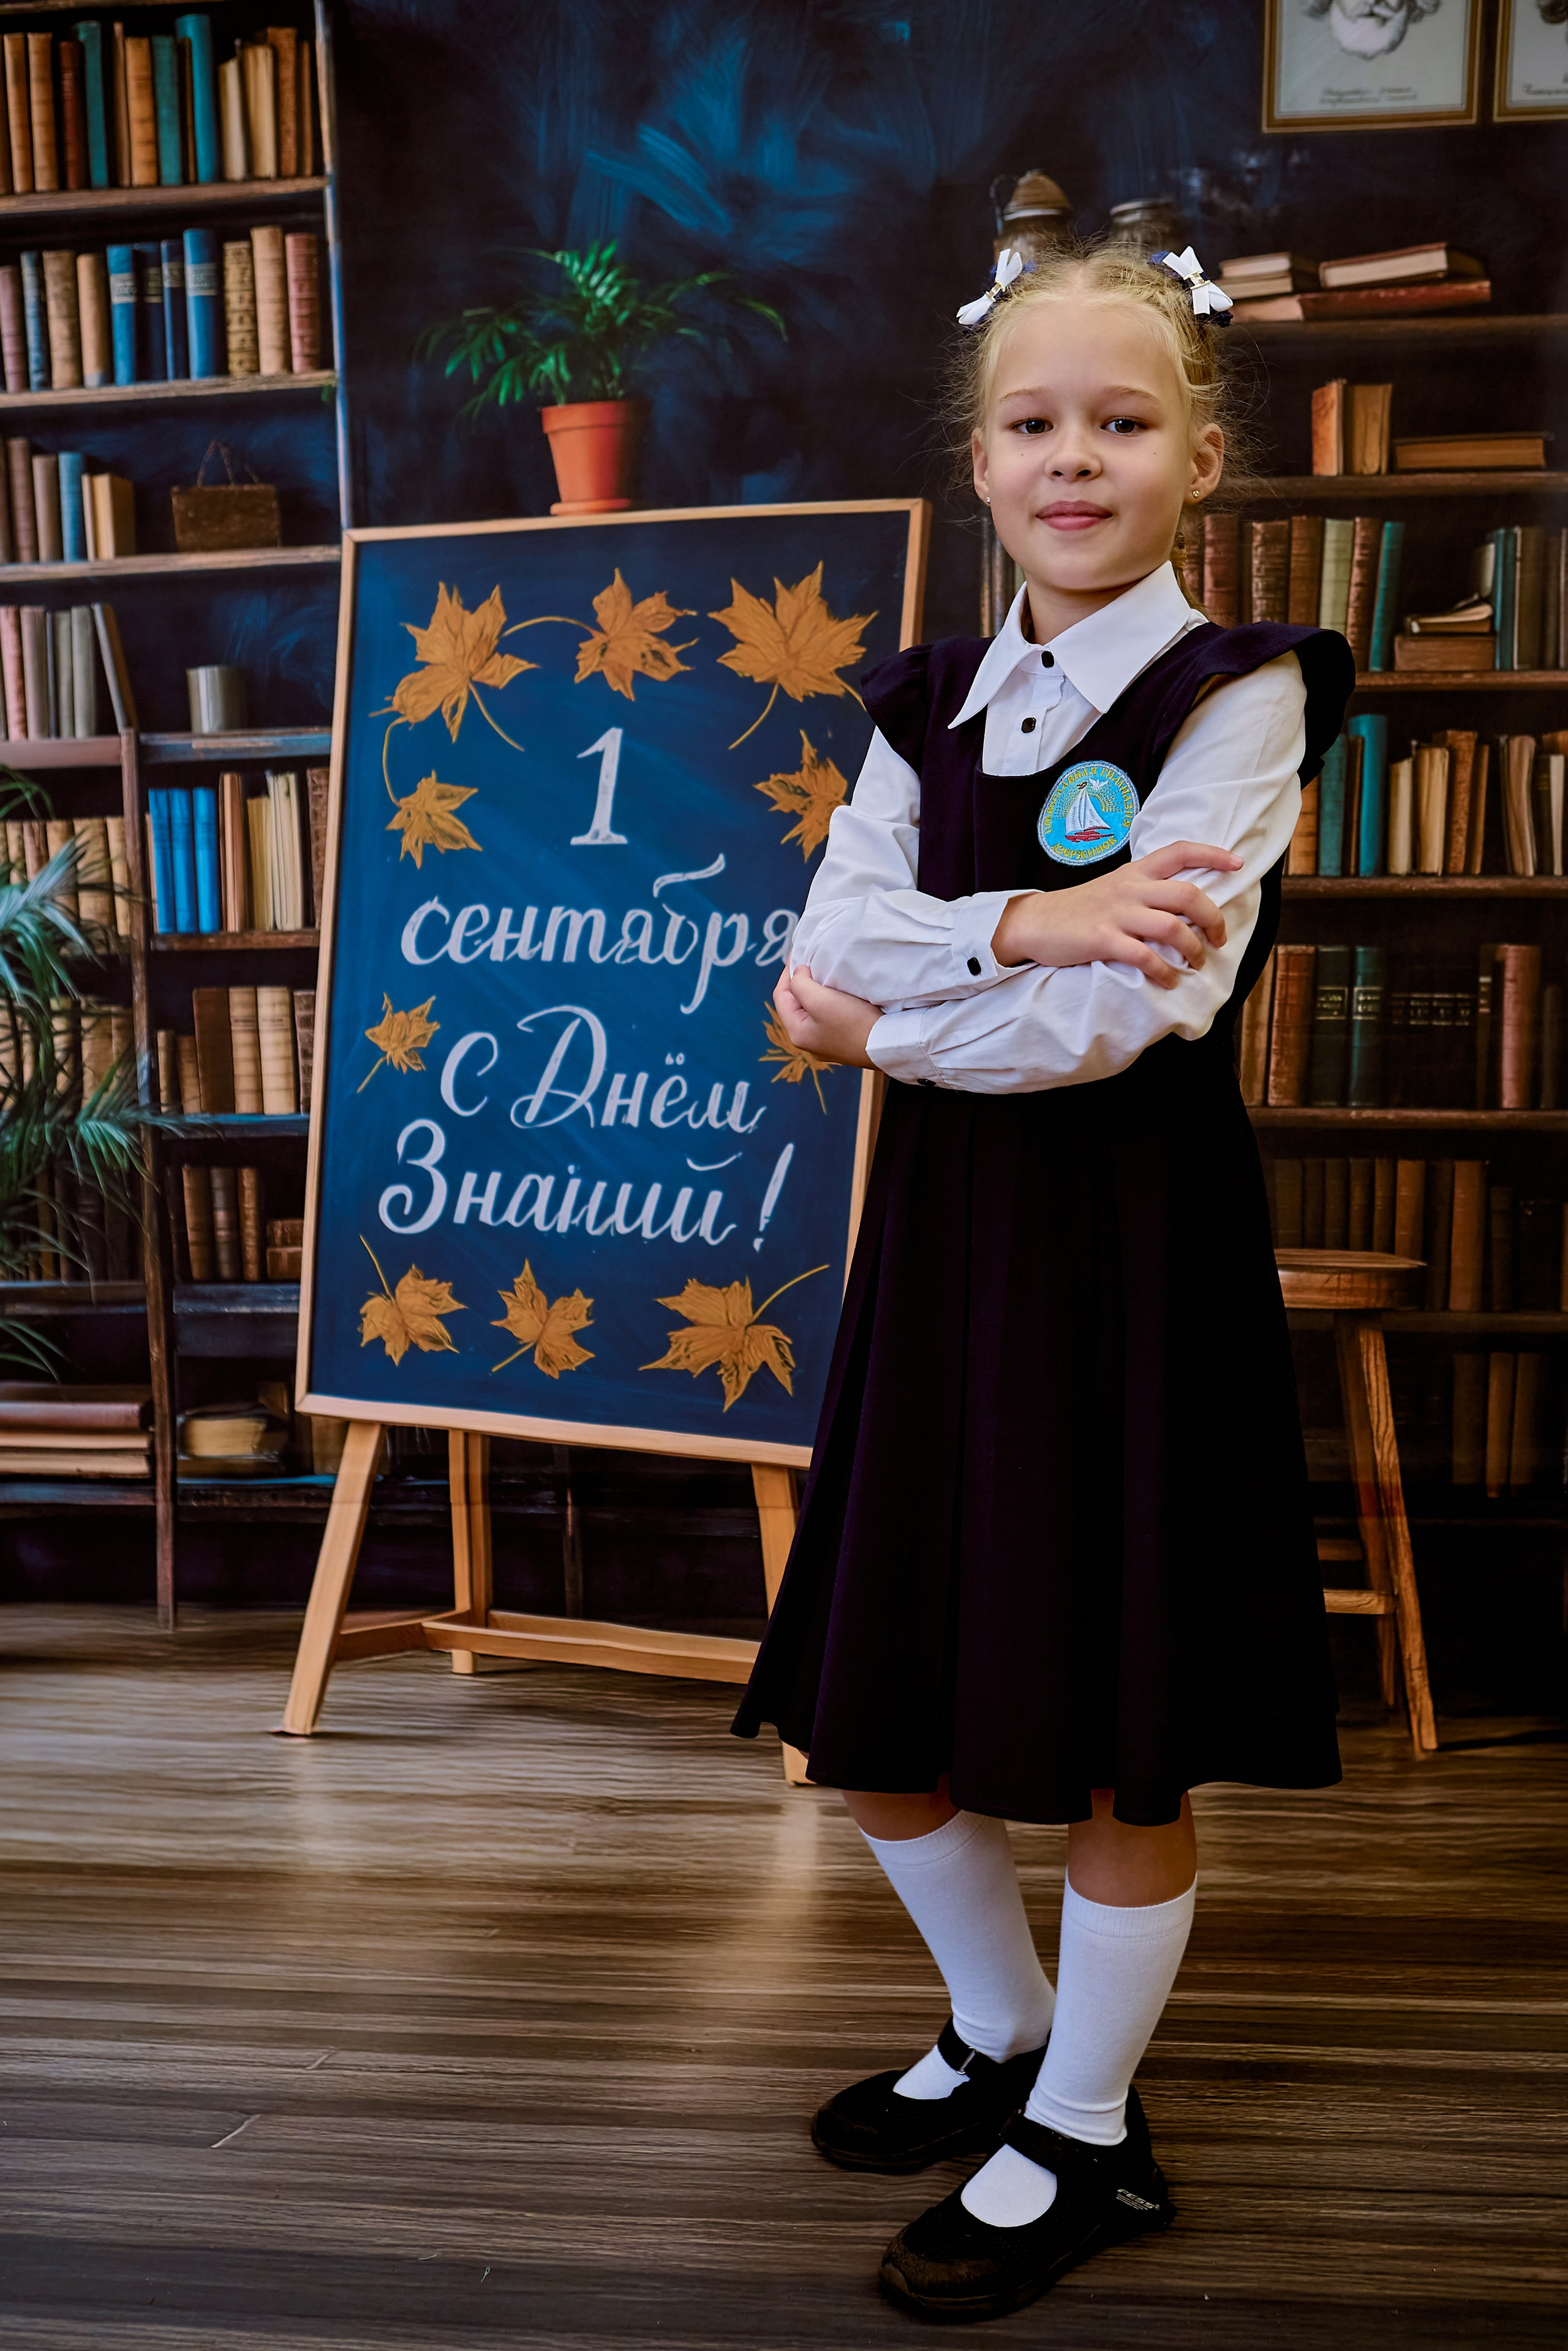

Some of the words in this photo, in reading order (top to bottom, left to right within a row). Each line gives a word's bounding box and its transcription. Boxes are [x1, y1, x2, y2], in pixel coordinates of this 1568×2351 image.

[570, 727, 628, 845] 1
[1044, 767, 1097, 834] ПРАВОСЛАВНАЯ
[1099, 768, 1134, 828] ГИМНАЗИЯ
[401, 853, 799, 1014] сентября
[510, 1005, 767, 1133] Днём
